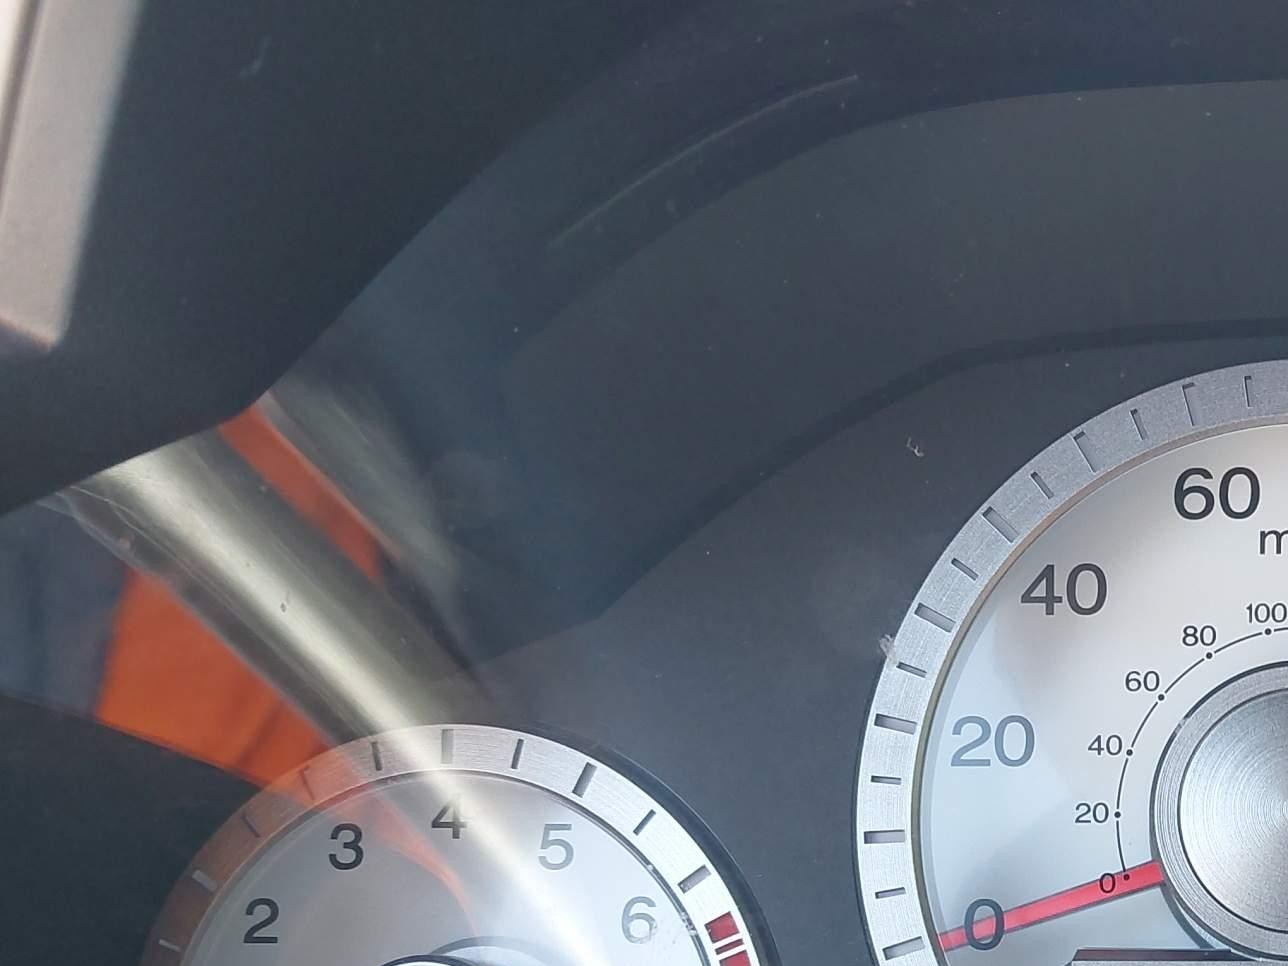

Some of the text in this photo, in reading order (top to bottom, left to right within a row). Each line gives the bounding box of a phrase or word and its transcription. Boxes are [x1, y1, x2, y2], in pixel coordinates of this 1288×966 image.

[1173, 467, 1261, 520] 60
[1020, 564, 1108, 616] 40
[1182, 625, 1217, 646] 80
[1246, 603, 1287, 624] 100
[1125, 671, 1160, 692] 60
[950, 715, 1035, 768] 20
[1087, 735, 1123, 756] 40
[431, 795, 467, 839] 4
[1074, 803, 1109, 824] 20
[328, 823, 364, 870] 3
[538, 823, 574, 870] 5
[1099, 873, 1117, 894] 0
[243, 898, 280, 944] 2
[621, 897, 657, 944] 6
[964, 898, 1005, 951] 0
